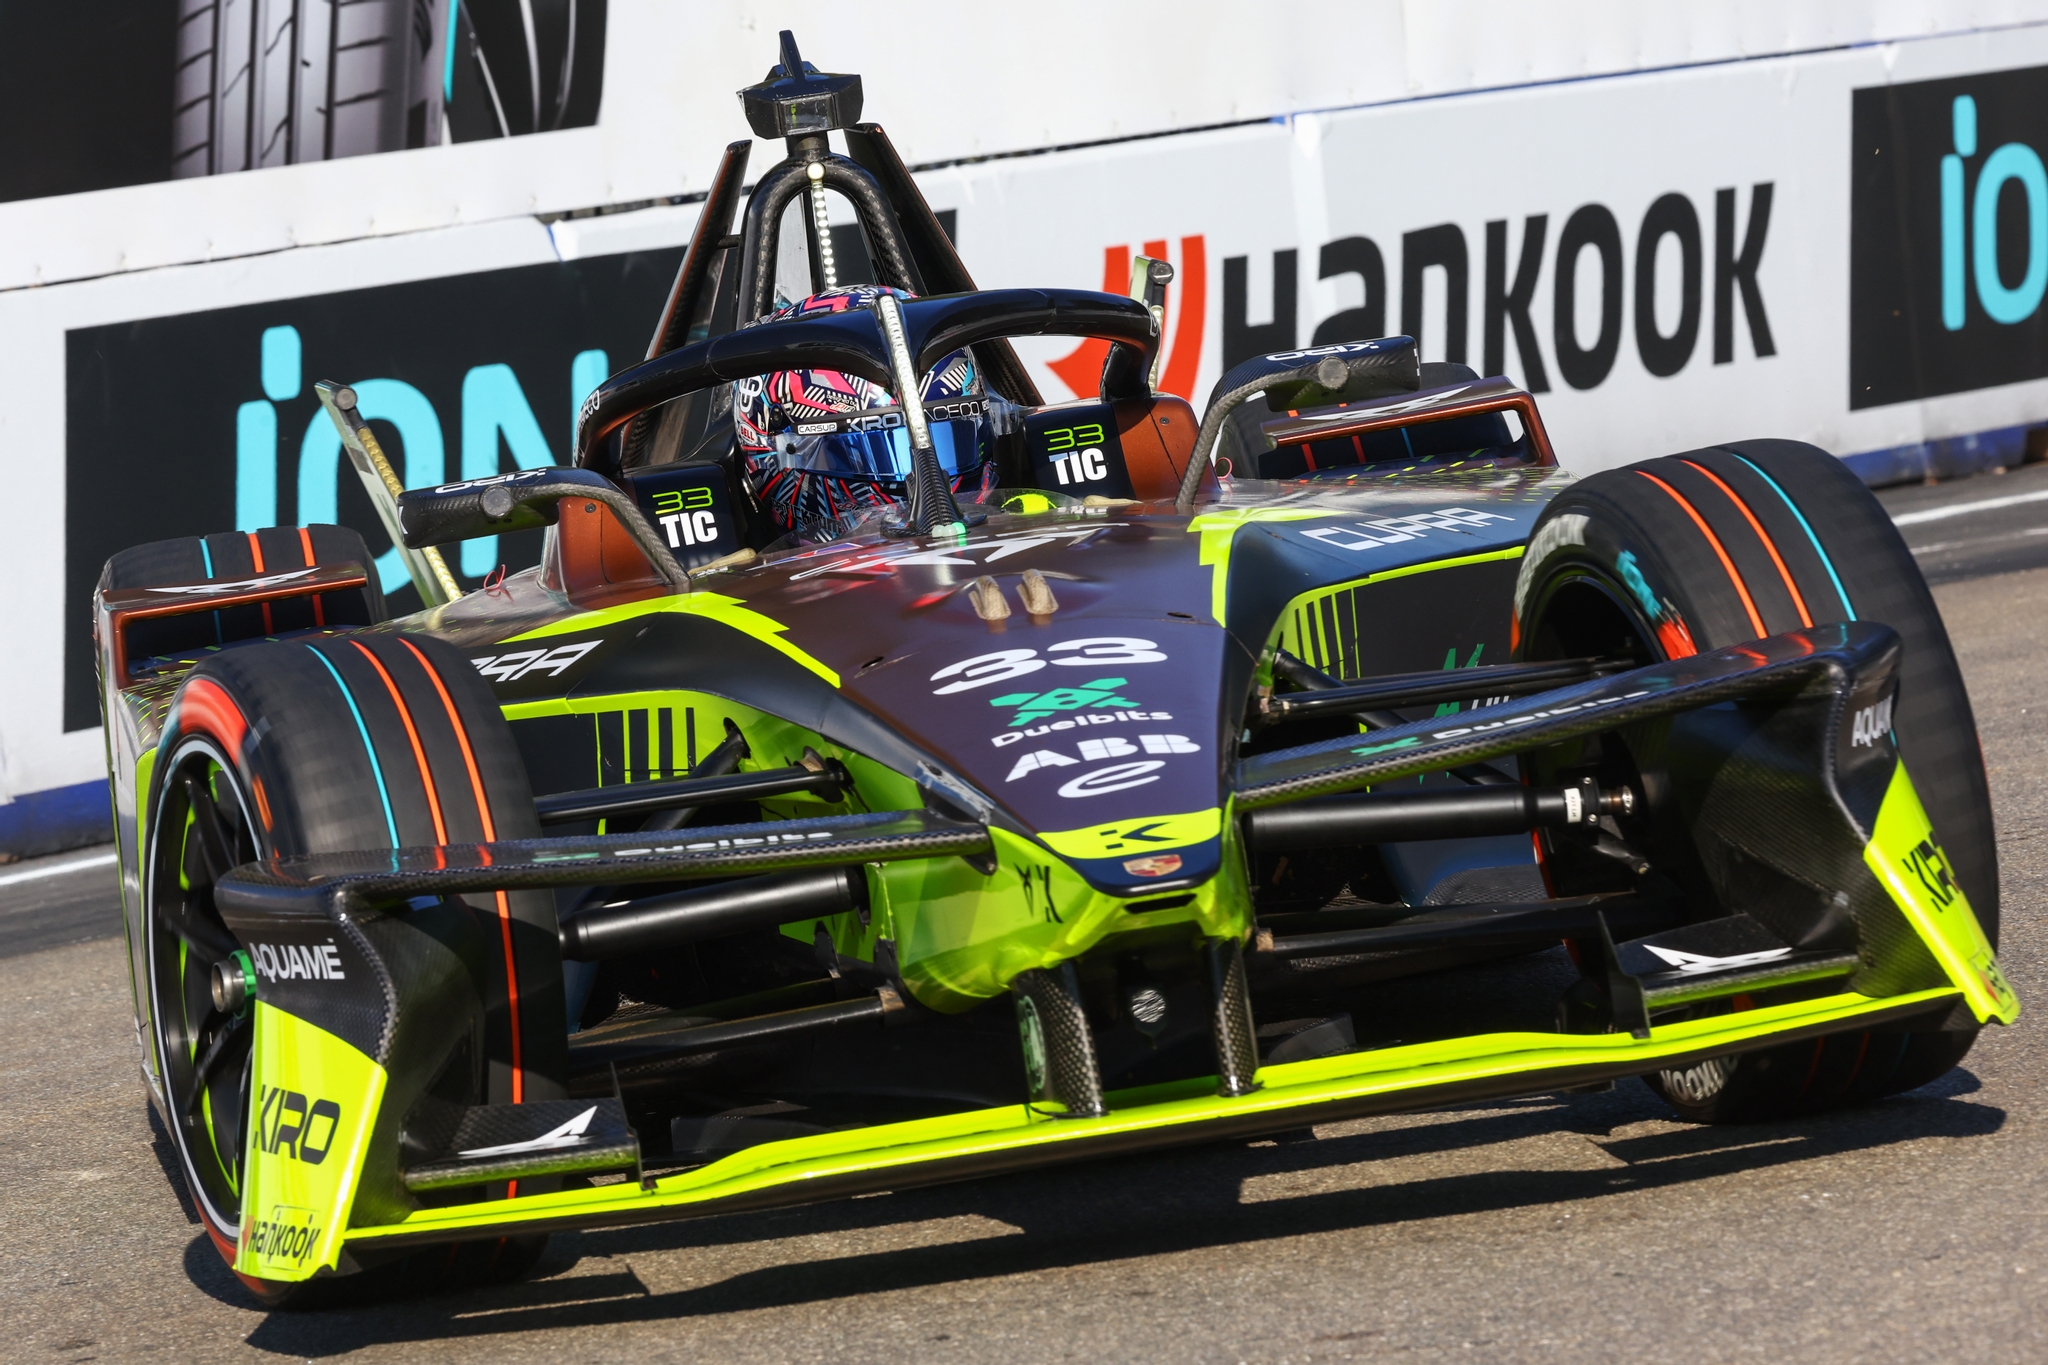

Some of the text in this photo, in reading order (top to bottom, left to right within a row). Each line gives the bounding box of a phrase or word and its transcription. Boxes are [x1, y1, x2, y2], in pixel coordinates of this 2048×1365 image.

[740, 426, 755, 441] BELL
[798, 423, 836, 434] CARSUP
[846, 413, 901, 432] KIRO
[1044, 423, 1105, 452] 33
[1048, 447, 1108, 485] TIC
[652, 486, 714, 515] 33
[659, 510, 718, 549] TIC
[932, 636, 1168, 695] 33
[990, 710, 1174, 748] Duelbits
[1005, 733, 1202, 783] ABB
[253, 1083, 341, 1165] KIRO
